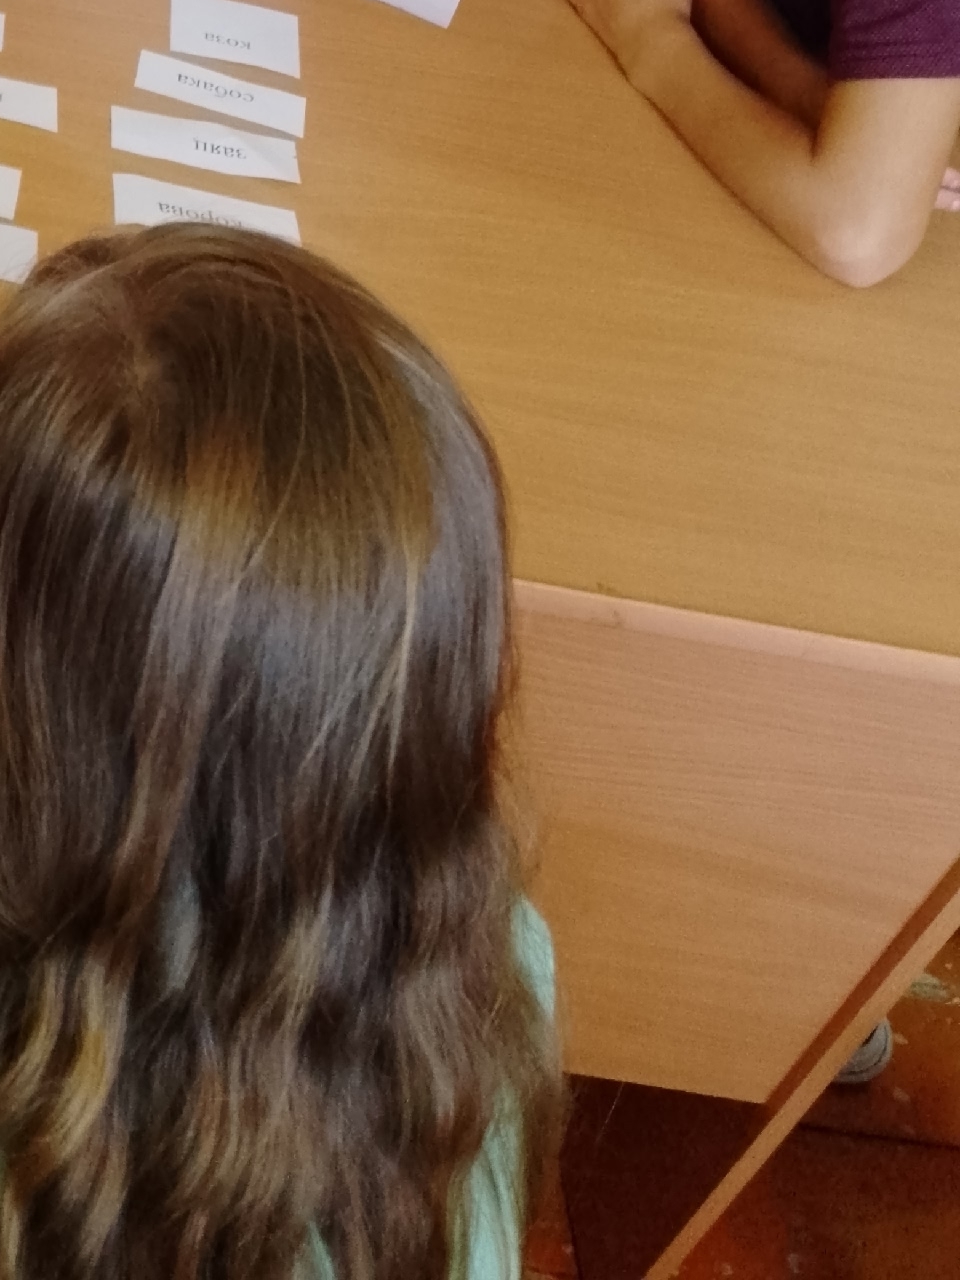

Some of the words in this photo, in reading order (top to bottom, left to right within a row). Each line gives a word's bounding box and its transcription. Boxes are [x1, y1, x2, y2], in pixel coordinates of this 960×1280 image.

[204, 31, 252, 51] коза
[177, 72, 256, 104] собака
[193, 136, 247, 160] заяц
[158, 201, 242, 227] корова
